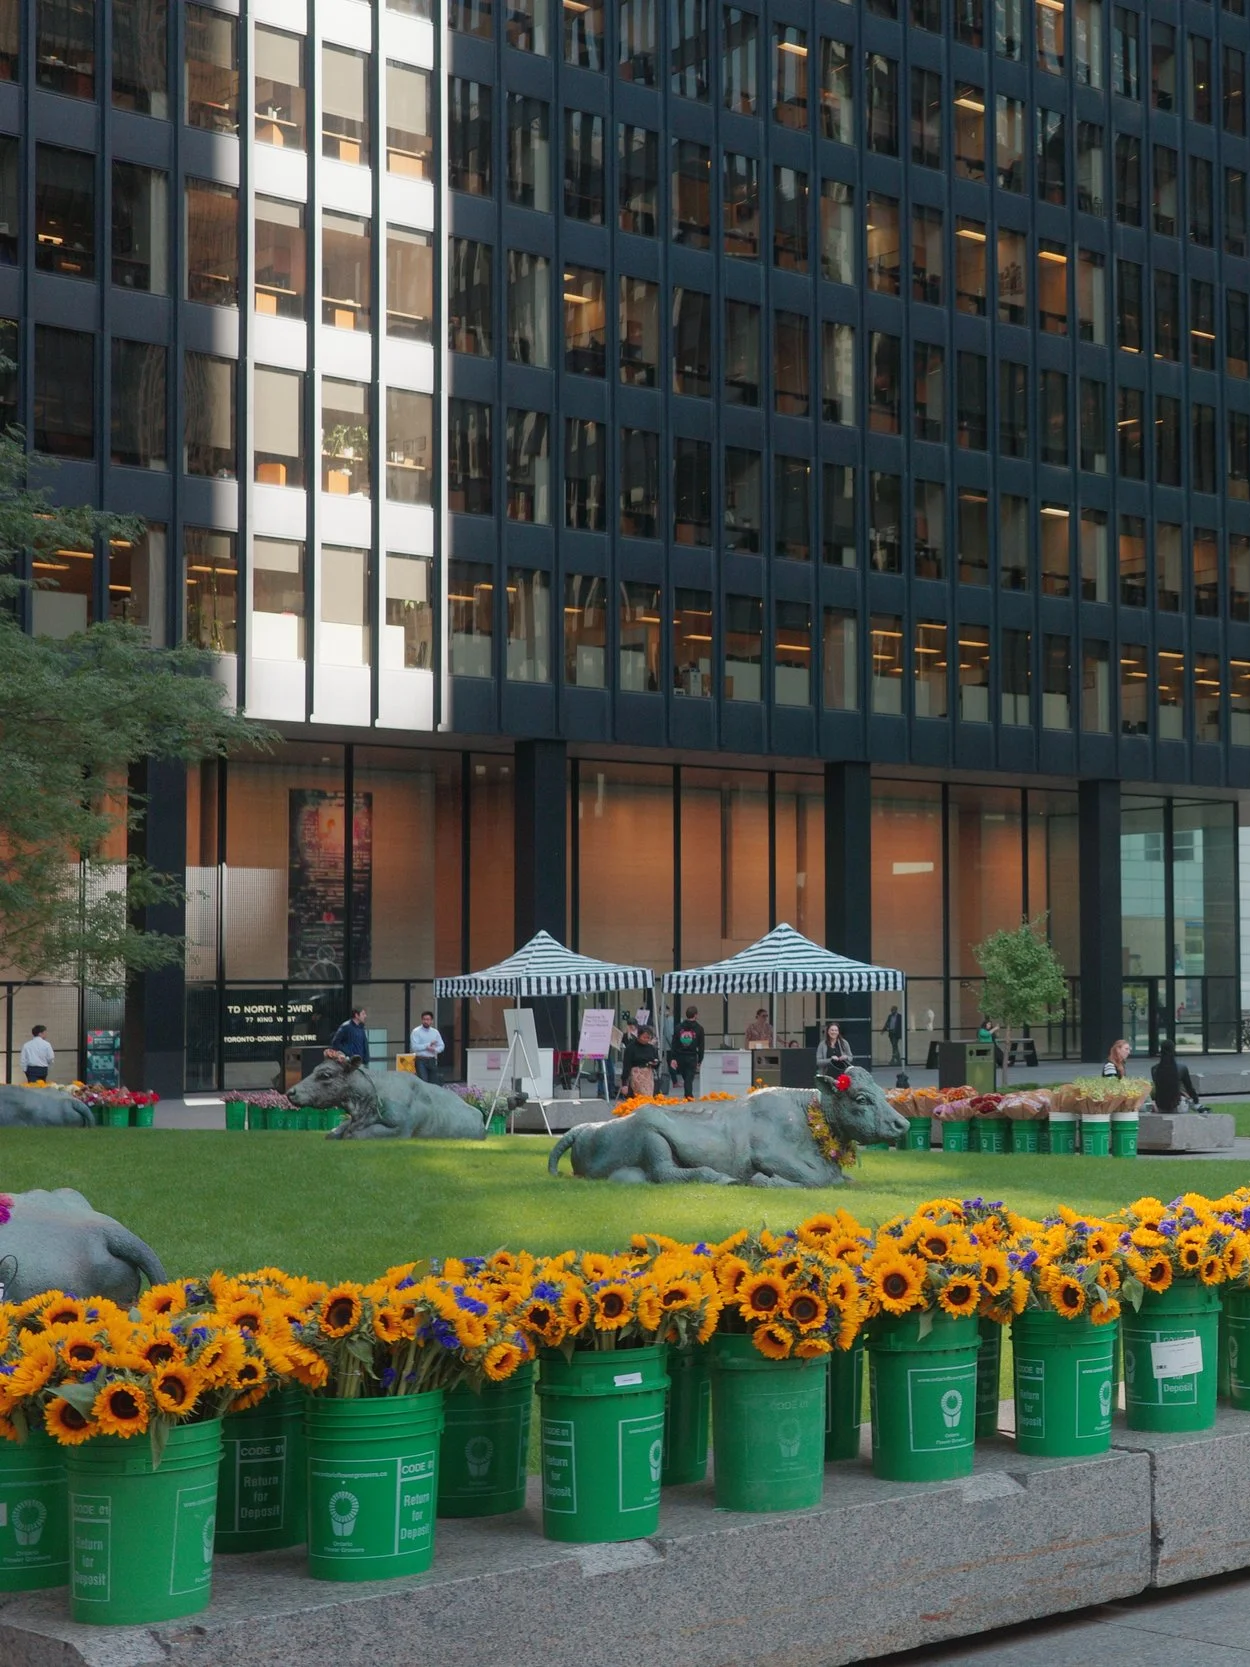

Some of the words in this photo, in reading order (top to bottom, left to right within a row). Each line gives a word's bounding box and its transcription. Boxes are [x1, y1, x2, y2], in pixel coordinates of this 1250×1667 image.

[227, 1005, 241, 1014] TD
[244, 1005, 277, 1013] NORTH
[291, 1034, 317, 1042] CENTRE
[1163, 1383, 1193, 1394] Deposit
[1024, 1403, 1034, 1413] for
[240, 1446, 271, 1457] CODE
[275, 1444, 284, 1454] 01
[401, 1462, 426, 1475] CODE
[551, 1470, 561, 1481] for
[243, 1476, 279, 1488] Return
[253, 1491, 269, 1502] for
[403, 1493, 430, 1507] Return
[98, 1505, 110, 1515] 01
[240, 1505, 280, 1519] Deposit
[411, 1510, 423, 1522] for
[400, 1523, 430, 1540] Deposit
[76, 1537, 103, 1551] Return
[82, 1555, 94, 1568] for
[74, 1571, 106, 1588] Deposit
